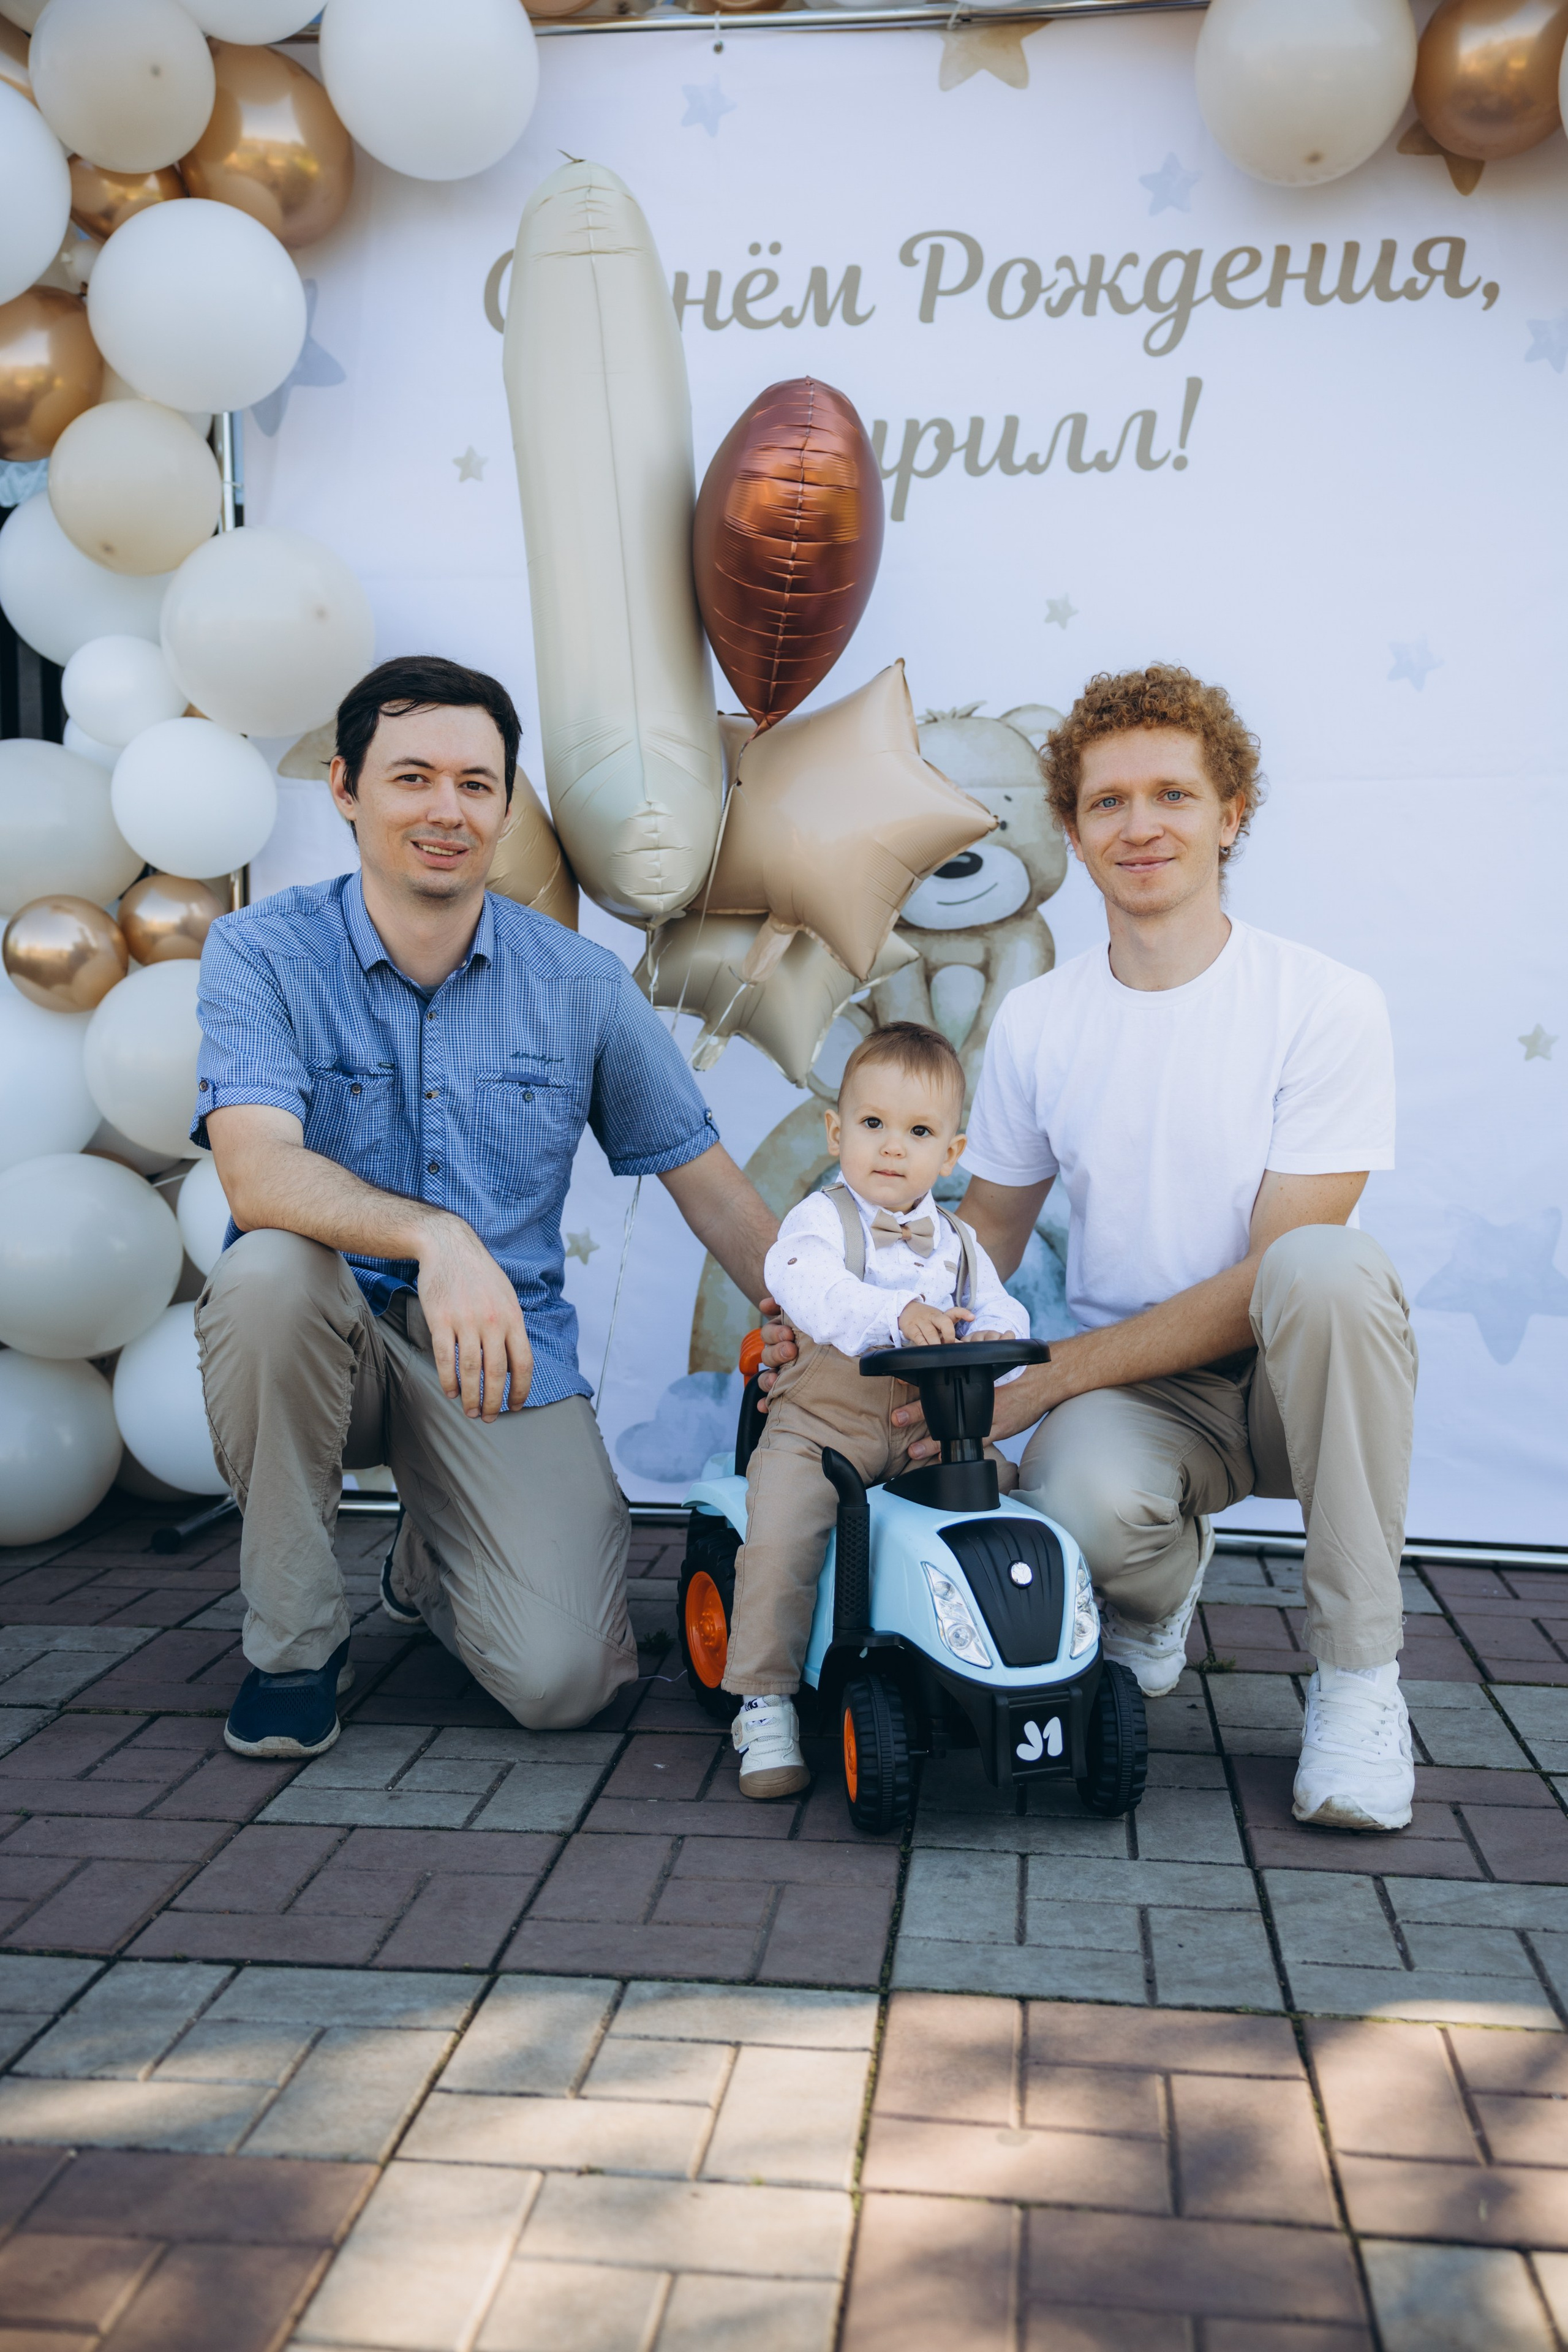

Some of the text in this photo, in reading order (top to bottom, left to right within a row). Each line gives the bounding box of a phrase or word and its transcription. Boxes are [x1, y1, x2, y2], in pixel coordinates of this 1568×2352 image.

[673, 241, 876, 331] нём
[899, 230, 1499, 357] Рождения,
[870, 376, 1203, 522] ирилл!
